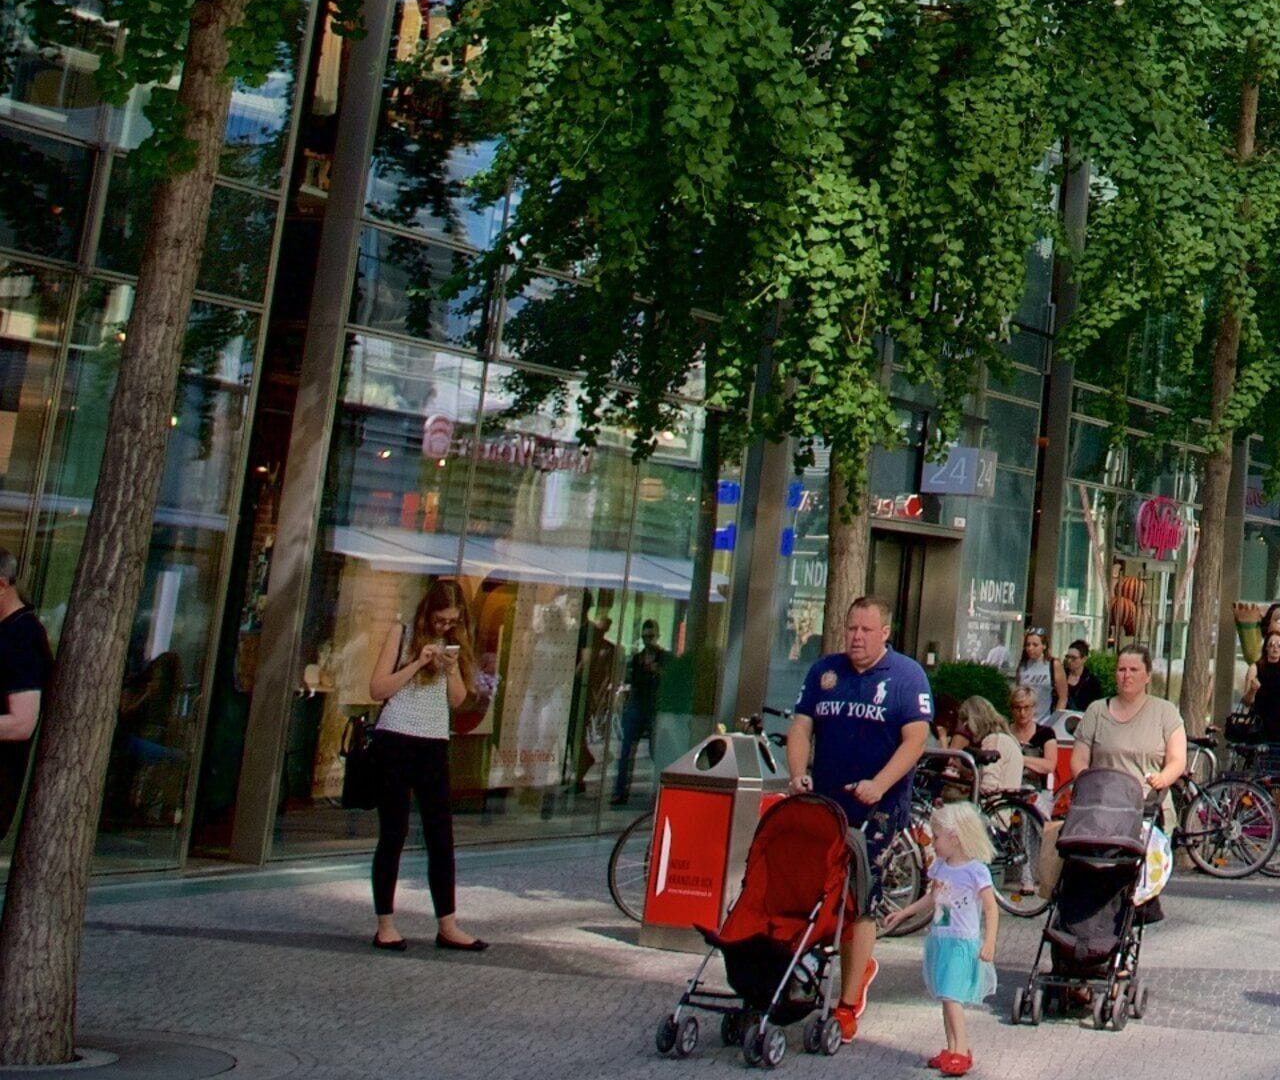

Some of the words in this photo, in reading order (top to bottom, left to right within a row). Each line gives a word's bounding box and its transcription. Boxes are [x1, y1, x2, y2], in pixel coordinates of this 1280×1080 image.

[929, 456, 968, 485] 24
[814, 700, 846, 716] NEW
[846, 701, 888, 723] YORK
[918, 693, 932, 715] 5
